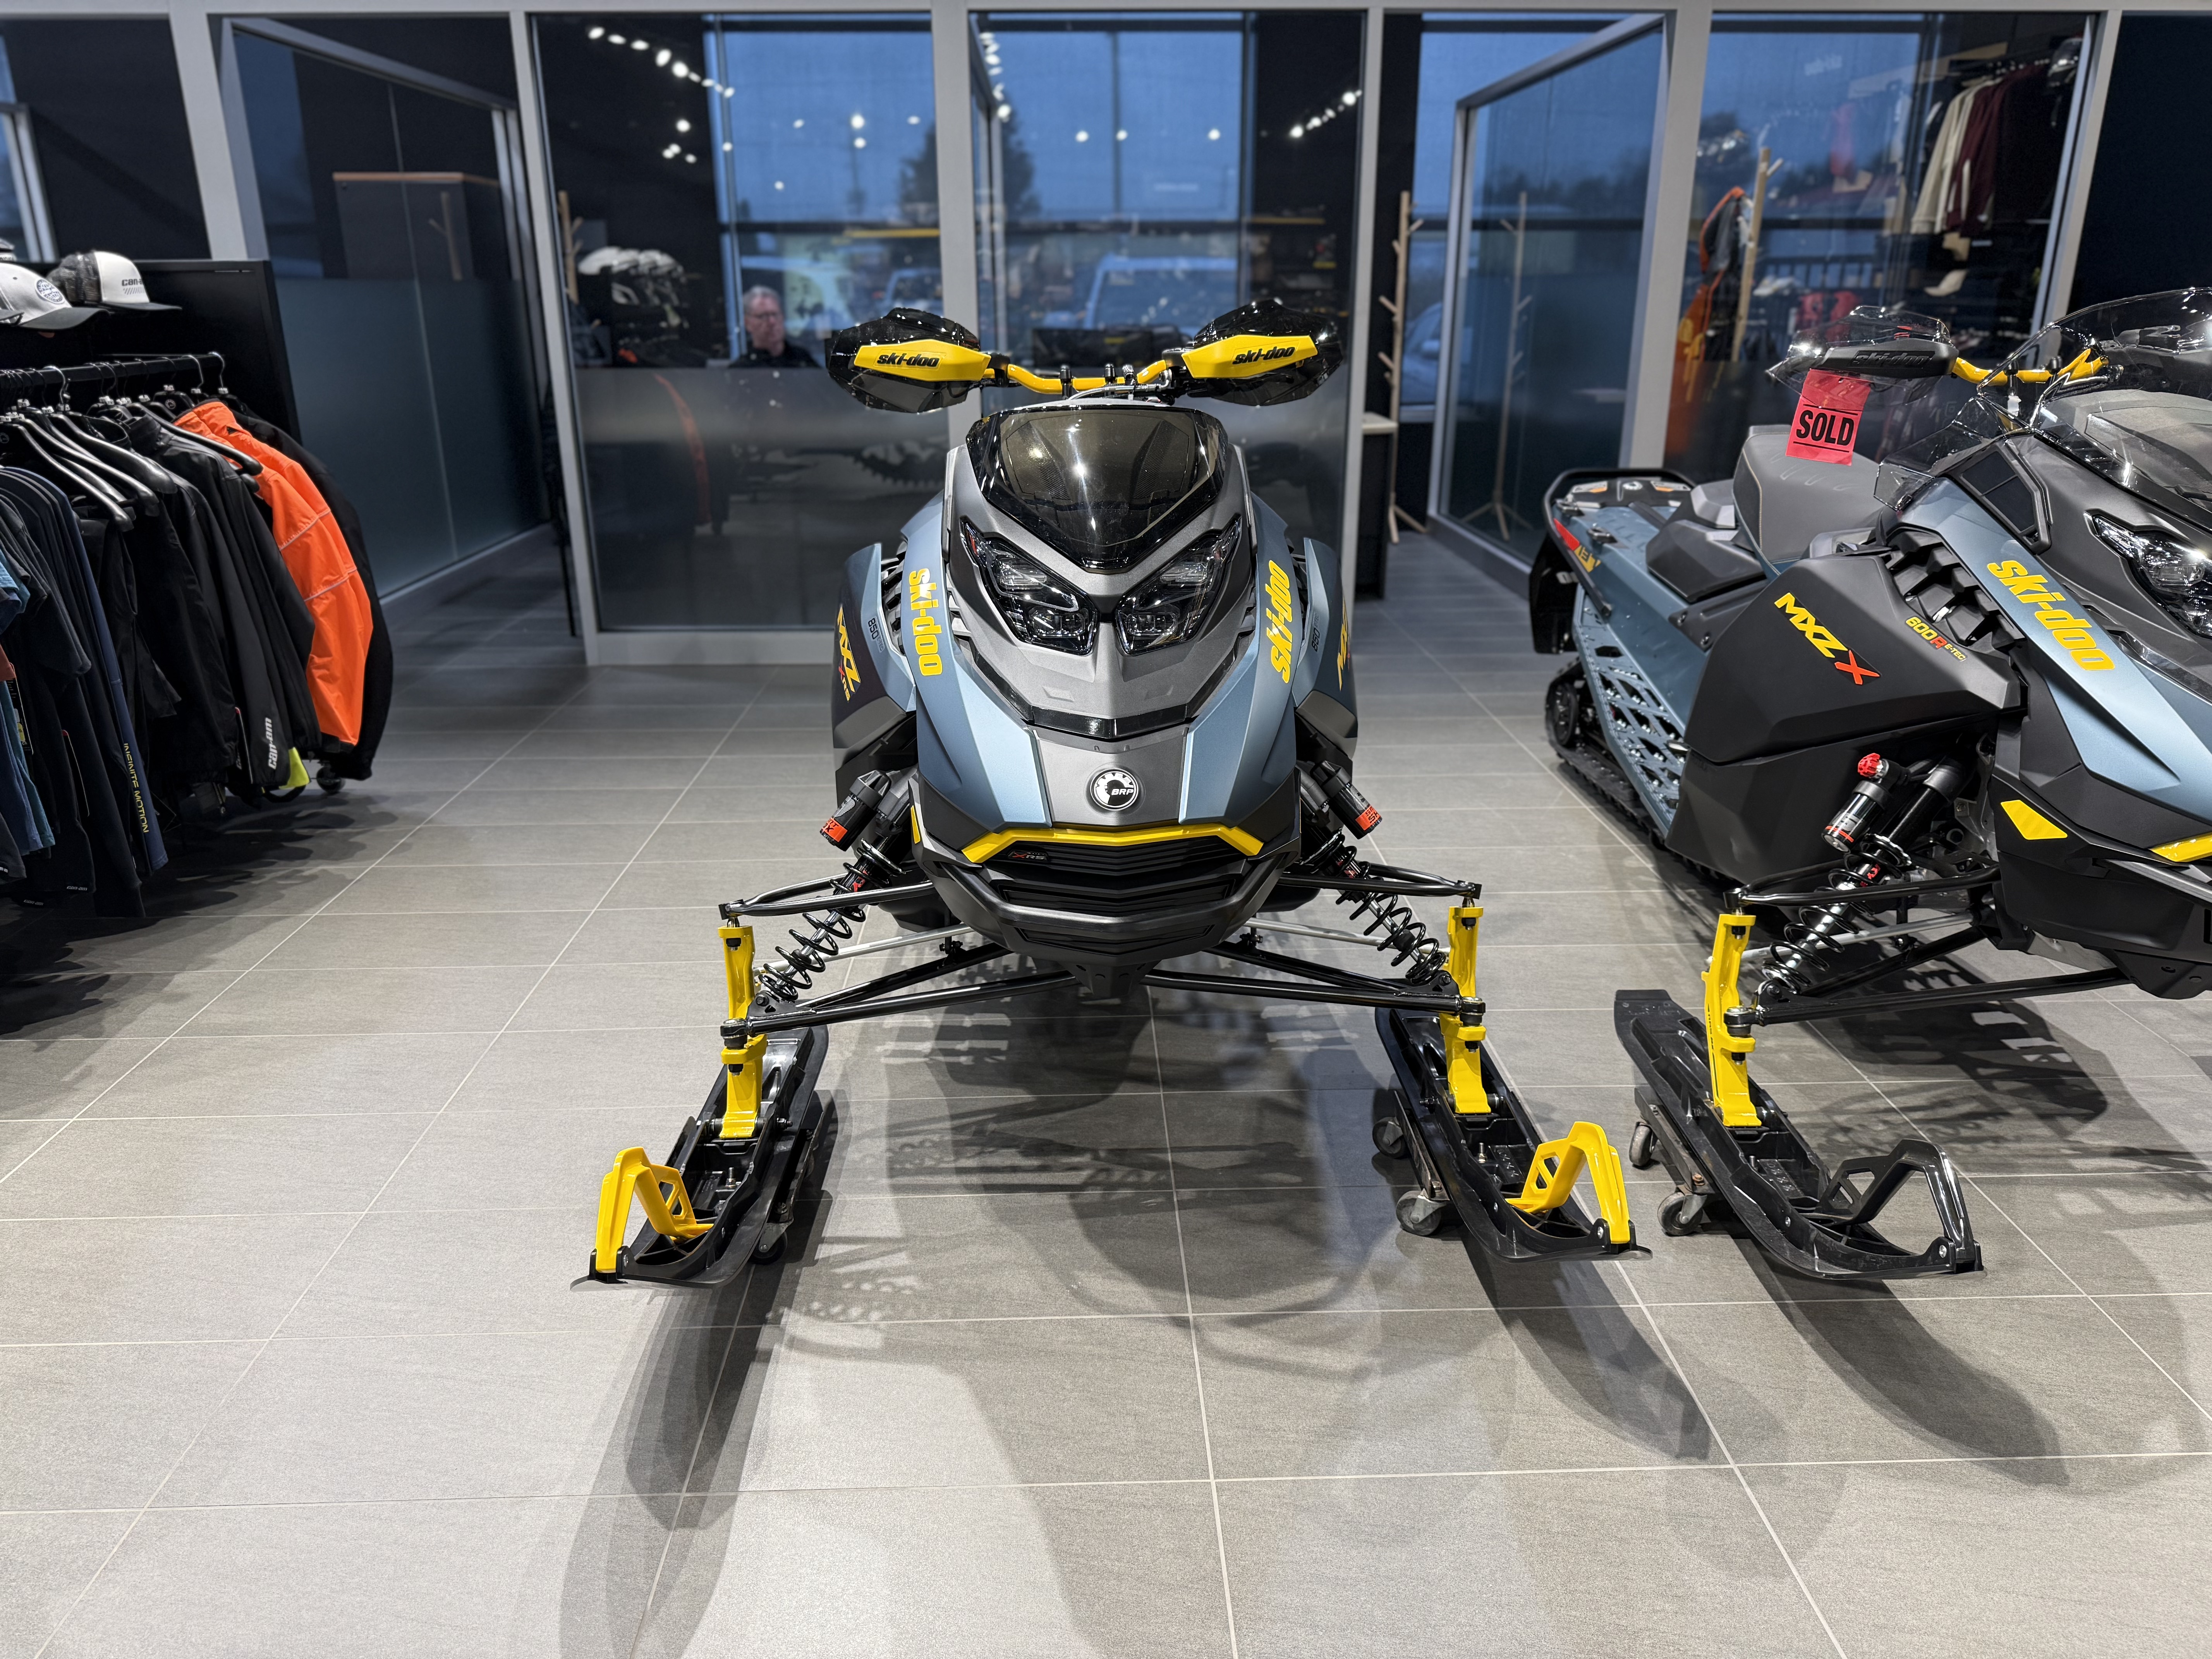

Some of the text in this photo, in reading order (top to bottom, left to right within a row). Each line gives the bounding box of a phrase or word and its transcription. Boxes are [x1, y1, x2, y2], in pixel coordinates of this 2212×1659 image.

[877, 352, 940, 367] ski-doo
[1232, 346, 1295, 365] ski-doo
[1854, 352, 1929, 366] ski-doo
[1796, 410, 1854, 446] SOLD
[868, 618, 879, 640] 850
[909, 568, 943, 676] ski-doo
[1265, 560, 1292, 684] ski-doo
[1987, 560, 2116, 671] ski-doo
[837, 605, 861, 692] MXZ
[1312, 628, 1320, 652] 850
[1774, 592, 1880, 685] MXZ X
[1906, 617, 1966, 660] 600R E-TEC
[265, 717, 278, 770] can-am
[134, 790, 149, 833] MOTION
[1012, 852, 1045, 860] XRS
